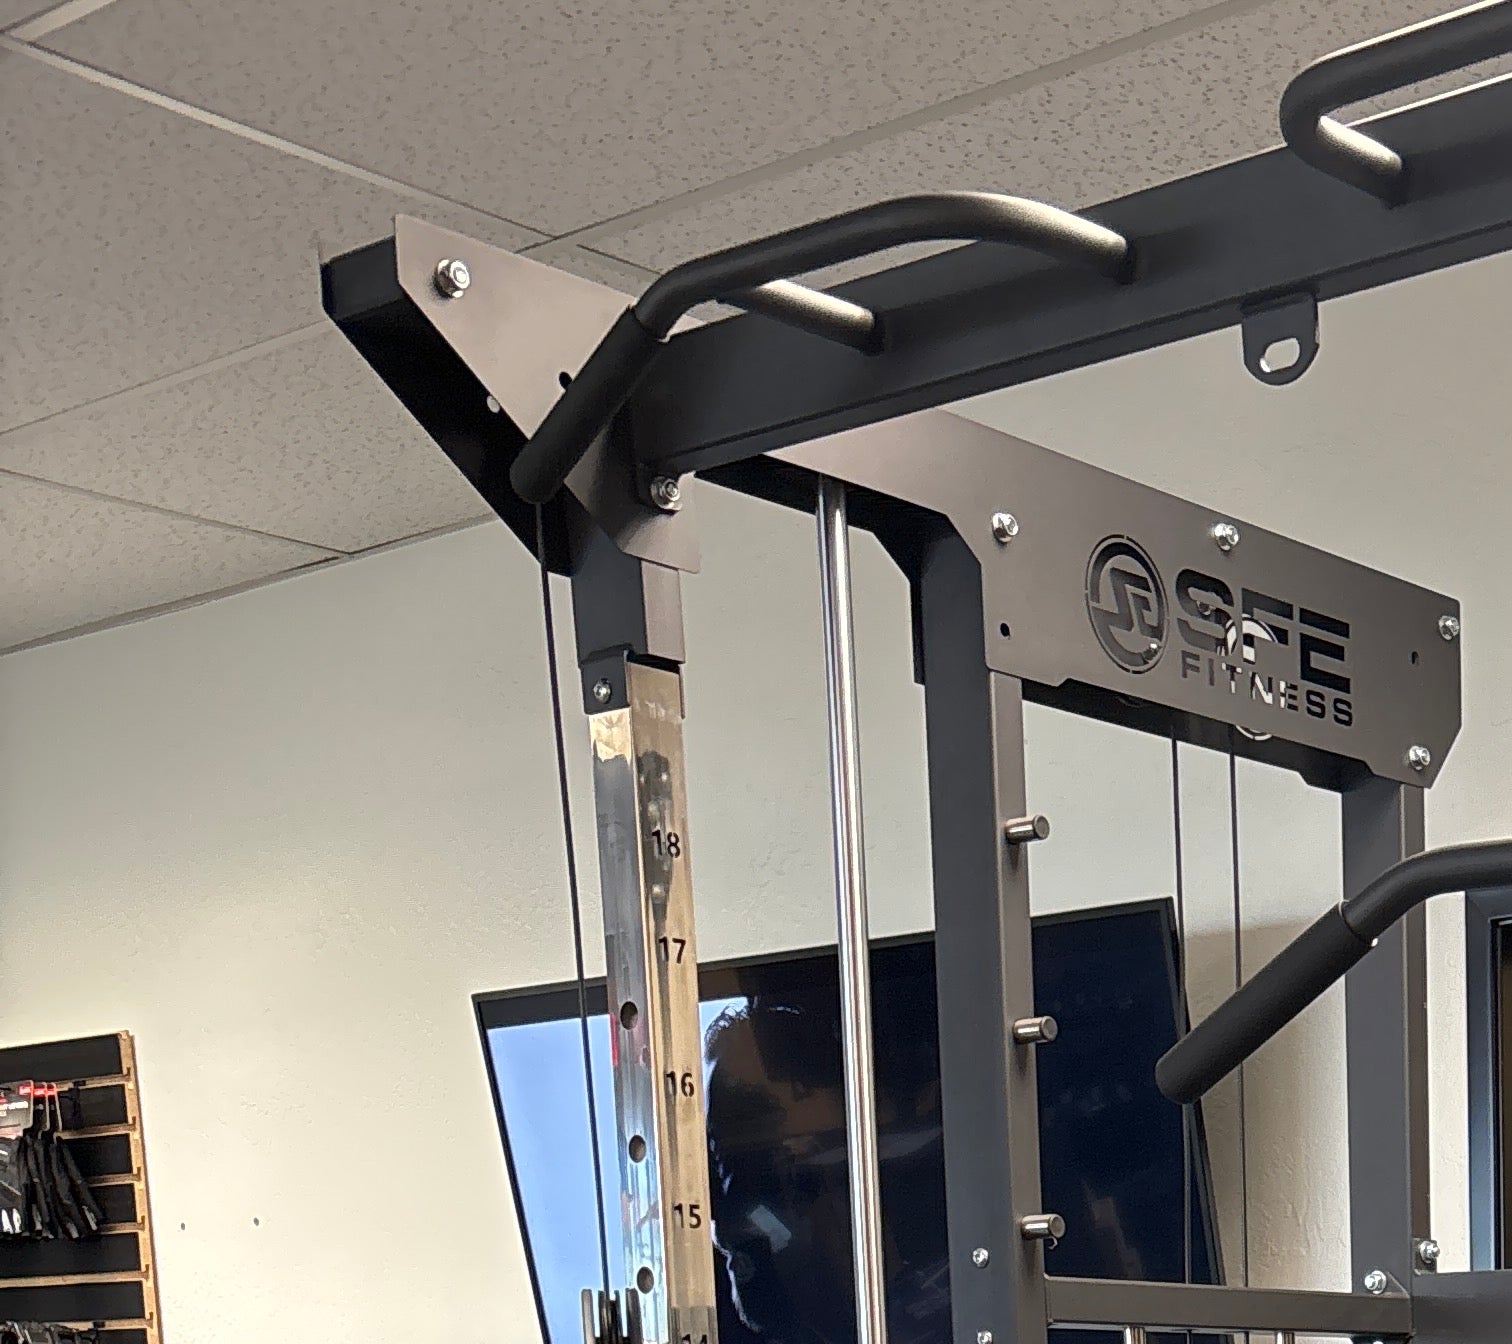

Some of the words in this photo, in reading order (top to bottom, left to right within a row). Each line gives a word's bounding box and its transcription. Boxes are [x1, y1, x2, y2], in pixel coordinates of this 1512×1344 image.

[1175, 567, 1352, 695] SFE
[1180, 650, 1354, 728] FITNESS
[652, 829, 681, 859] 18
[658, 936, 687, 965] 17
[666, 1072, 695, 1099] 16
[673, 1203, 703, 1230] 15
